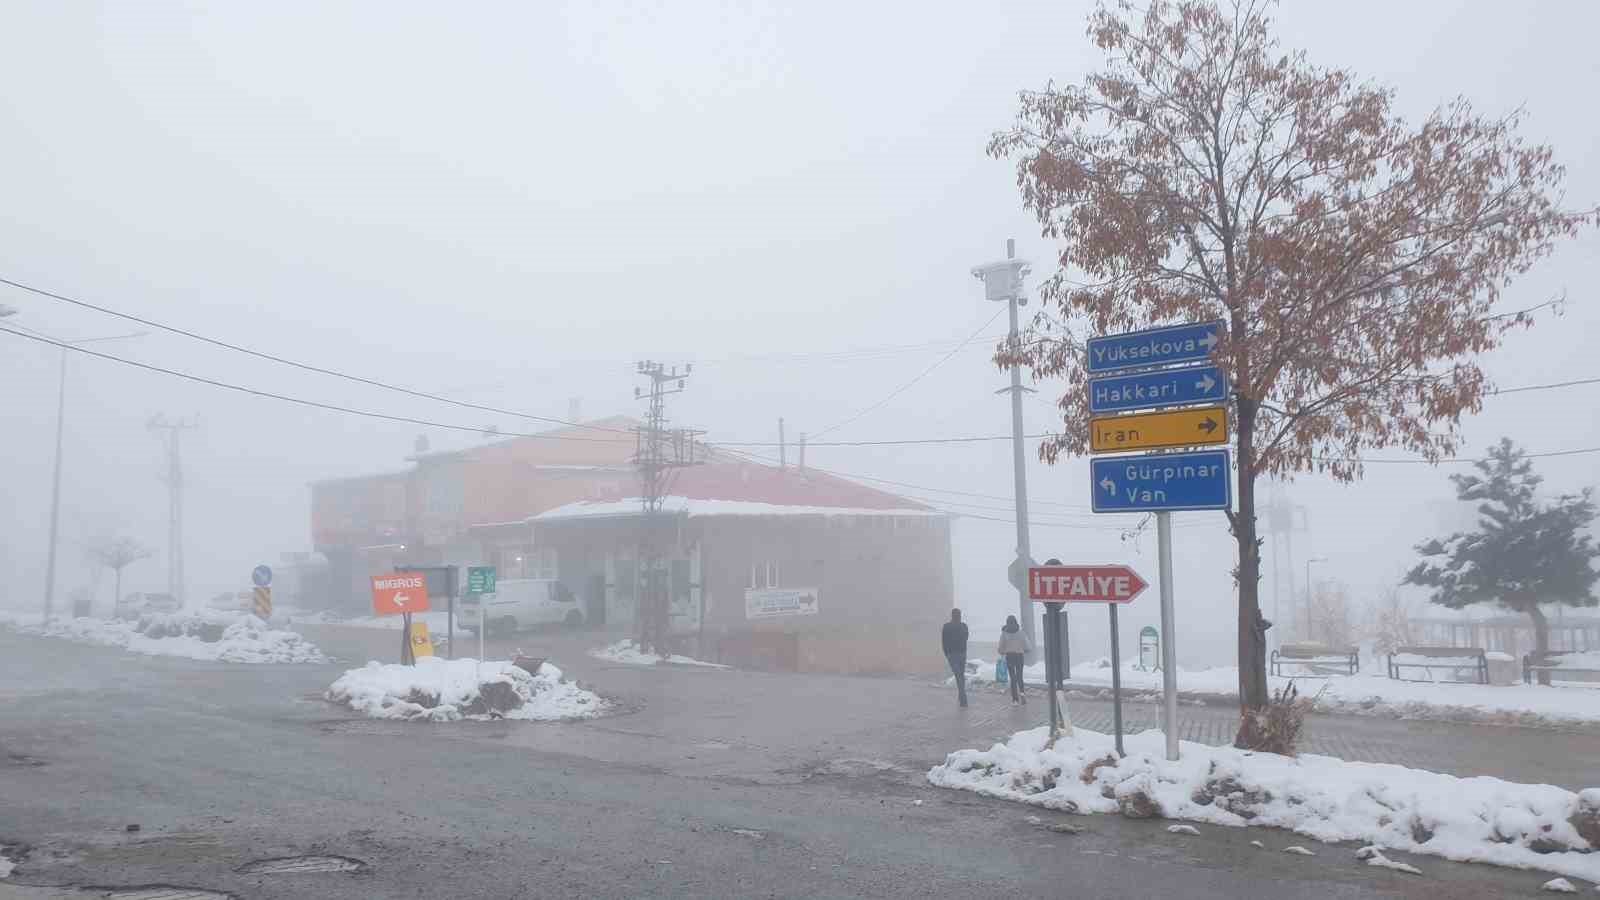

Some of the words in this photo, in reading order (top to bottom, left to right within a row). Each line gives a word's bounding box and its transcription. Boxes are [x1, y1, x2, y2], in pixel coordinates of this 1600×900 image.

[1096, 381, 1177, 404] Hakkari
[1126, 487, 1166, 503] Van
[1034, 571, 1130, 596] İTFAİYE
